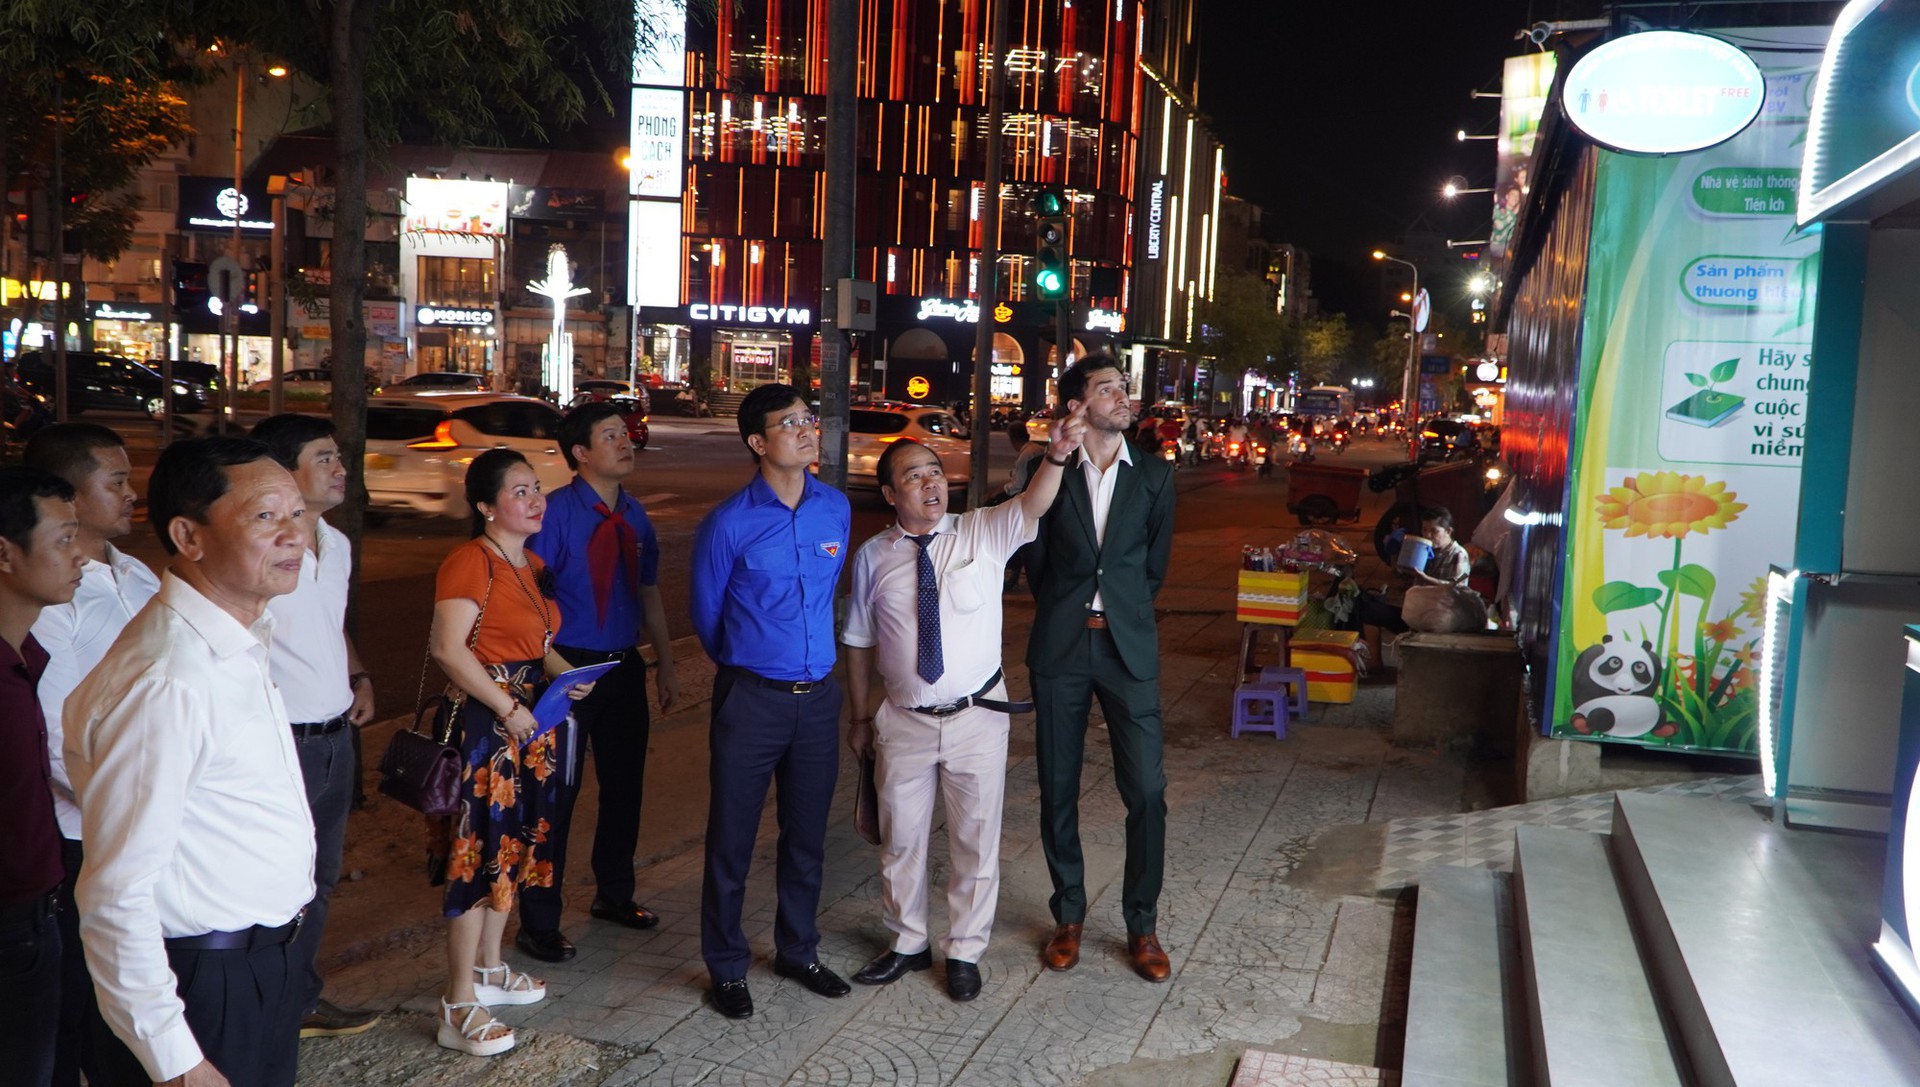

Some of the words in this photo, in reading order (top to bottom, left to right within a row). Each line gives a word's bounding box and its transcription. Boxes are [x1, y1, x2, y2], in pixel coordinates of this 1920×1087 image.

[1721, 87, 1750, 98] FREE
[638, 115, 677, 137] PHONG
[1742, 175, 1763, 189] sinh
[1150, 180, 1164, 223] CENTRAL
[1148, 223, 1161, 259] LIBERTY
[690, 304, 810, 325] CITIGYM
[1758, 348, 1796, 371] Hãy
[1754, 398, 1801, 420] cuộc
[1753, 422, 1773, 438] vì
